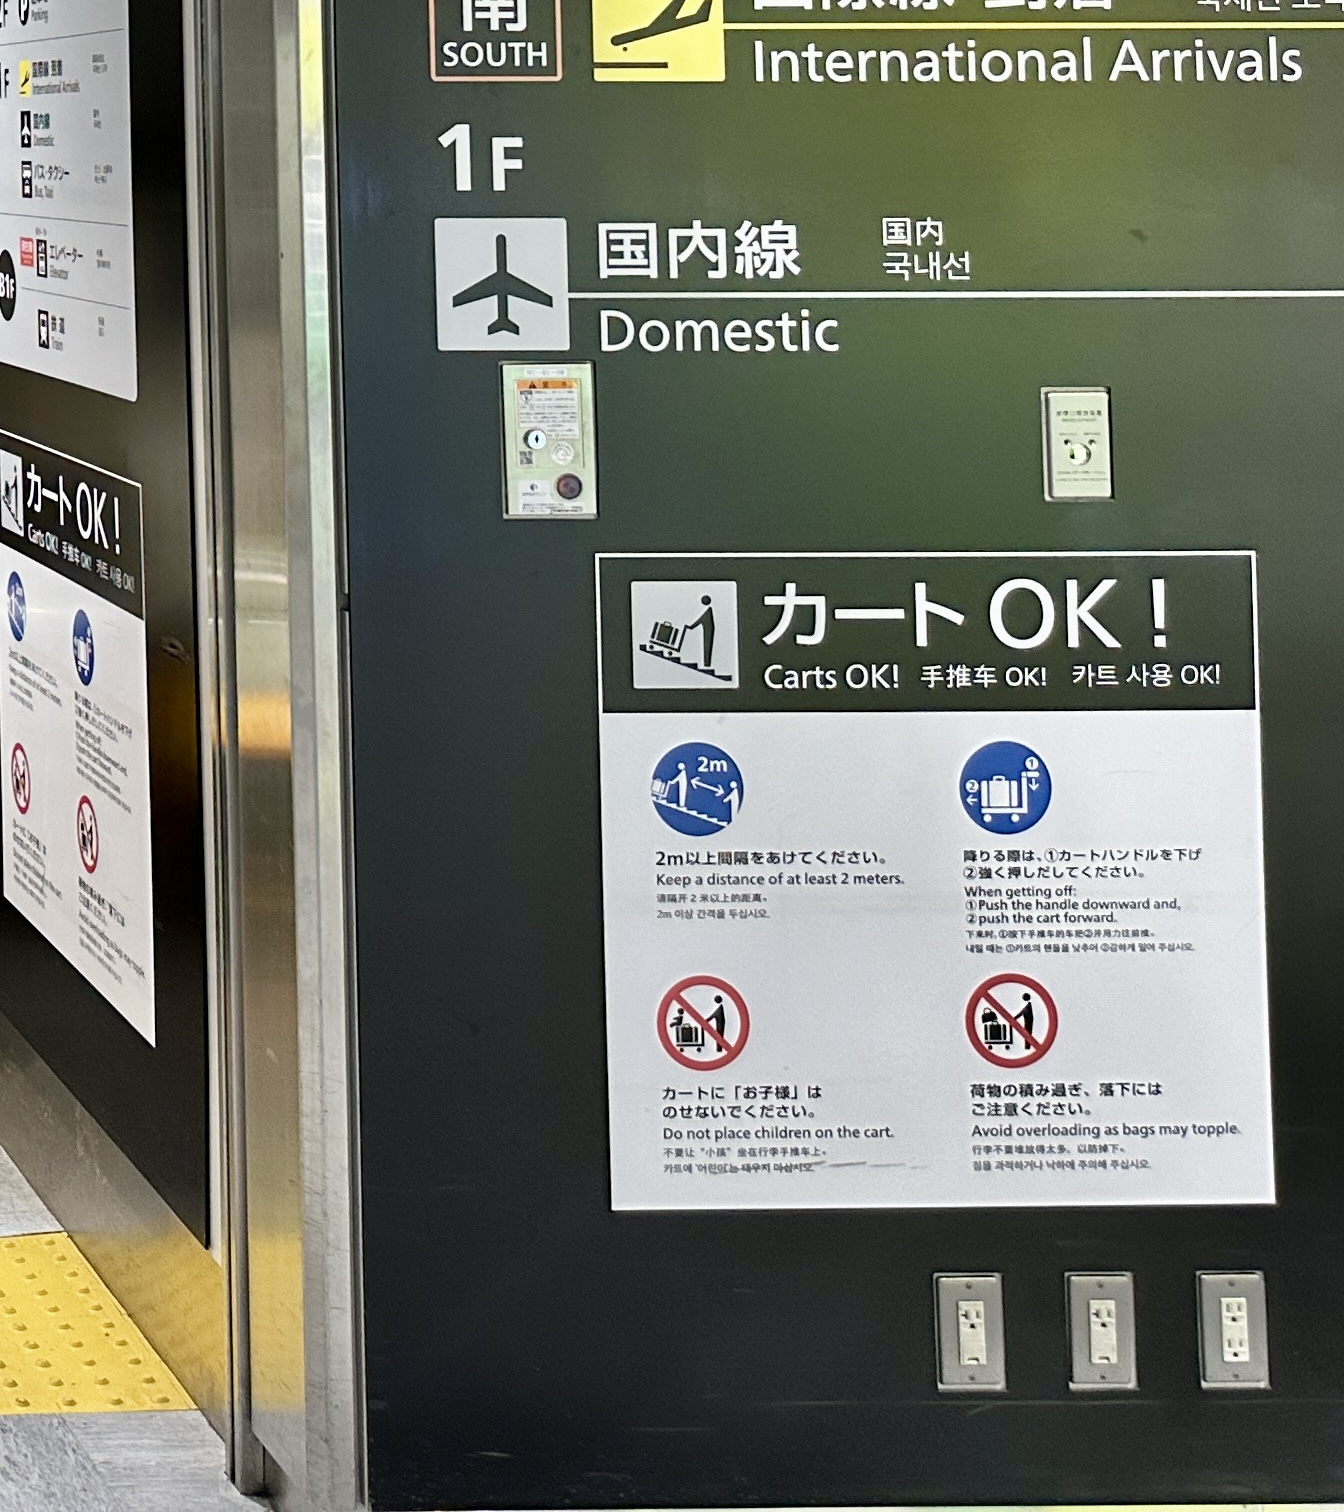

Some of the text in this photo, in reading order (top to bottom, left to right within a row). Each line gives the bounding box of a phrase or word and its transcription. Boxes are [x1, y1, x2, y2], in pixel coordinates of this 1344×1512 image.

[442, 41, 548, 68] SOUTH
[753, 38, 1303, 84] International Arrivals
[437, 123, 525, 192] 1F
[882, 216, 943, 246] 国内
[597, 220, 803, 280] 国内線
[882, 251, 971, 281] 국내선
[0, 272, 15, 299] B1F
[599, 309, 840, 354] Domestic
[27, 463, 72, 526] カート
[761, 581, 965, 648] カート
[764, 664, 900, 690] Carts OK!
[920, 664, 1047, 689] 手推车 OK!
[1071, 664, 1221, 687] 카트 사용 OK!
[697, 756, 728, 773] 2m
[655, 850, 887, 867] 2m以上間隔をあけてください。
[656, 872, 905, 888] Keep a distance of at least 2 meters.
[964, 885, 1077, 900] When getting off:
[1011, 899, 1033, 910] the
[1035, 899, 1079, 910] handle
[1082, 898, 1150, 910] downward
[1153, 898, 1181, 911] and,
[1013, 912, 1034, 924] the
[1036, 912, 1061, 924] cart
[1064, 911, 1118, 923] forward.
[662, 1105, 816, 1119] のせないでください。
[971, 1103, 1092, 1117] ご注意ください。
[663, 1126, 895, 1143] Do not place children on the cart.
[971, 1122, 1241, 1138] Avoid overloading as bags may topple.
